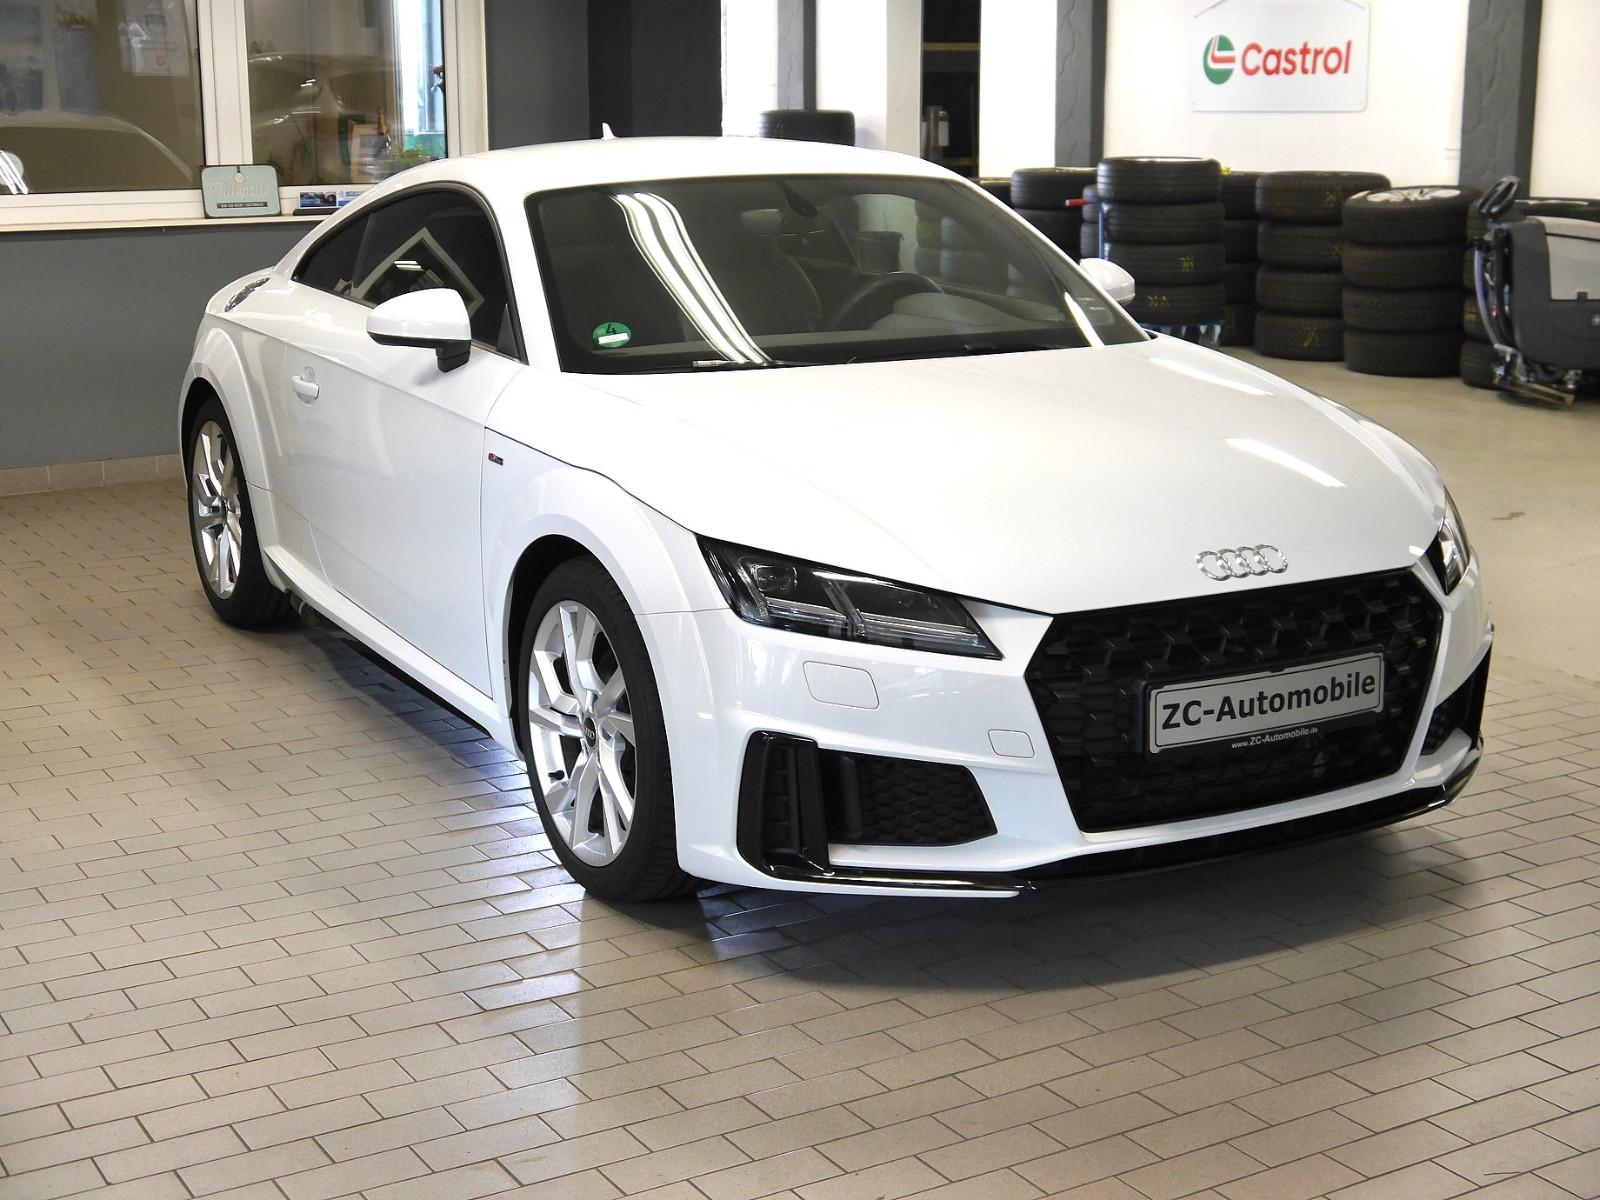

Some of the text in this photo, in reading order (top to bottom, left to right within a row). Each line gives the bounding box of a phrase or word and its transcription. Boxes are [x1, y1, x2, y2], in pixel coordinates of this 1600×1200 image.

[1241, 40, 1353, 76] Castrol
[606, 323, 616, 335] 4
[1162, 672, 1376, 730] ZC-Automobile
[1231, 726, 1318, 749] www.ZC-Automobile.de
